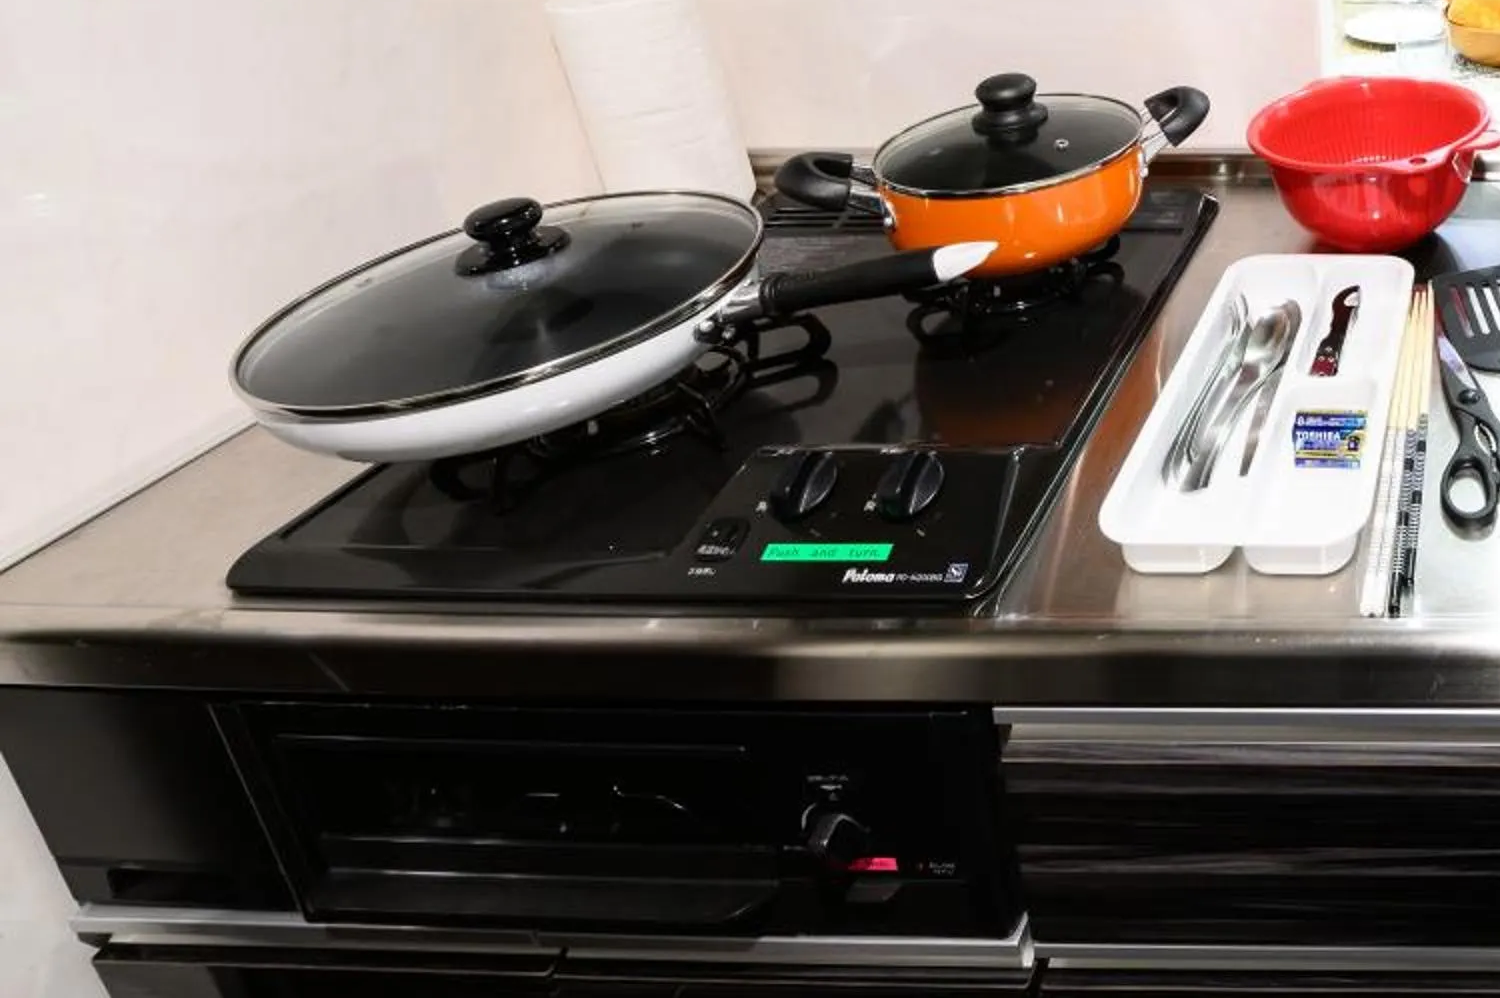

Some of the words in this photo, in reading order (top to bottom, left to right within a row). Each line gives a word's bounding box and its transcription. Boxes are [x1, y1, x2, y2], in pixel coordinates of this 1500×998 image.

[1296, 430, 1341, 442] TOSHIBA
[767, 547, 800, 557] Push
[808, 547, 837, 558] and
[842, 567, 896, 583] Paloma
